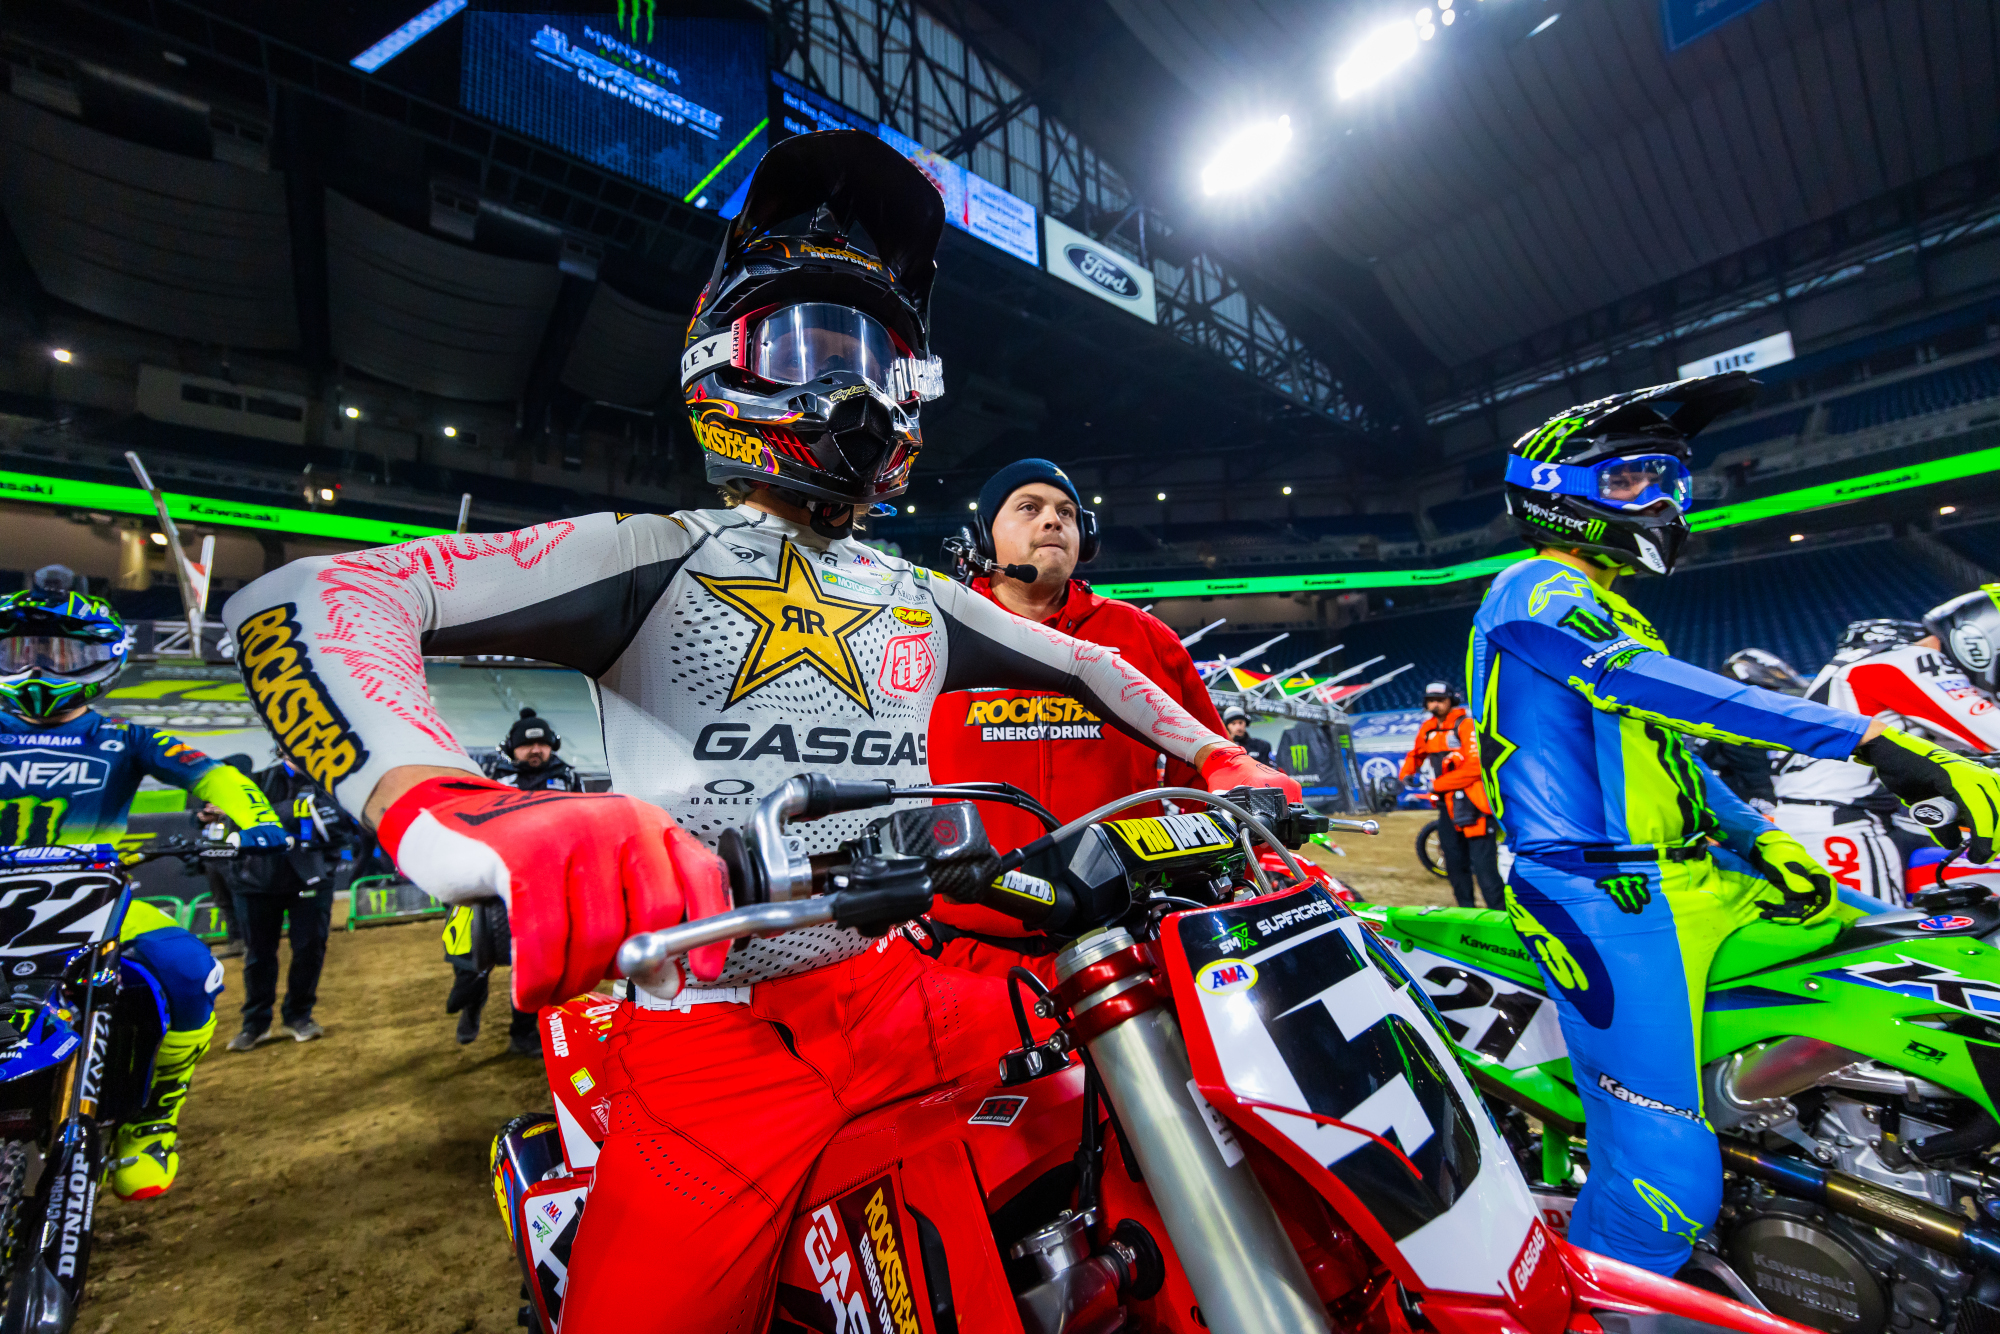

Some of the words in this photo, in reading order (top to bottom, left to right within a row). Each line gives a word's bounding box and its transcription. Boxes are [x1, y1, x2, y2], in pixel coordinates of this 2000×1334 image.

[1080, 252, 1128, 294] Ford
[189, 503, 280, 524] Kawasaki
[853, 554, 878, 569] AMA
[837, 576, 880, 595] MOTOREX
[896, 609, 931, 623] FMF
[238, 606, 356, 797] ROCKSTAR
[966, 697, 1101, 724] ROCKSTA
[18, 734, 83, 746] YAMAHA
[693, 722, 927, 766] GASGAS
[982, 726, 1047, 741] ENERGY
[1050, 725, 1102, 739] DRINK
[1256, 899, 1333, 937] SUPERCROSS
[1460, 934, 1531, 962] Kawasaki
[1211, 964, 1250, 989] AMA
[1423, 966, 1543, 1063] 21
[549, 1017, 570, 1057] DUNLOP
[978, 1100, 1019, 1115] ETS
[57, 1152, 89, 1278] DUNLOP
[542, 1200, 563, 1224] AMA
[859, 1231, 885, 1308] ENERGY
[1514, 1225, 1546, 1292] GASGAS
